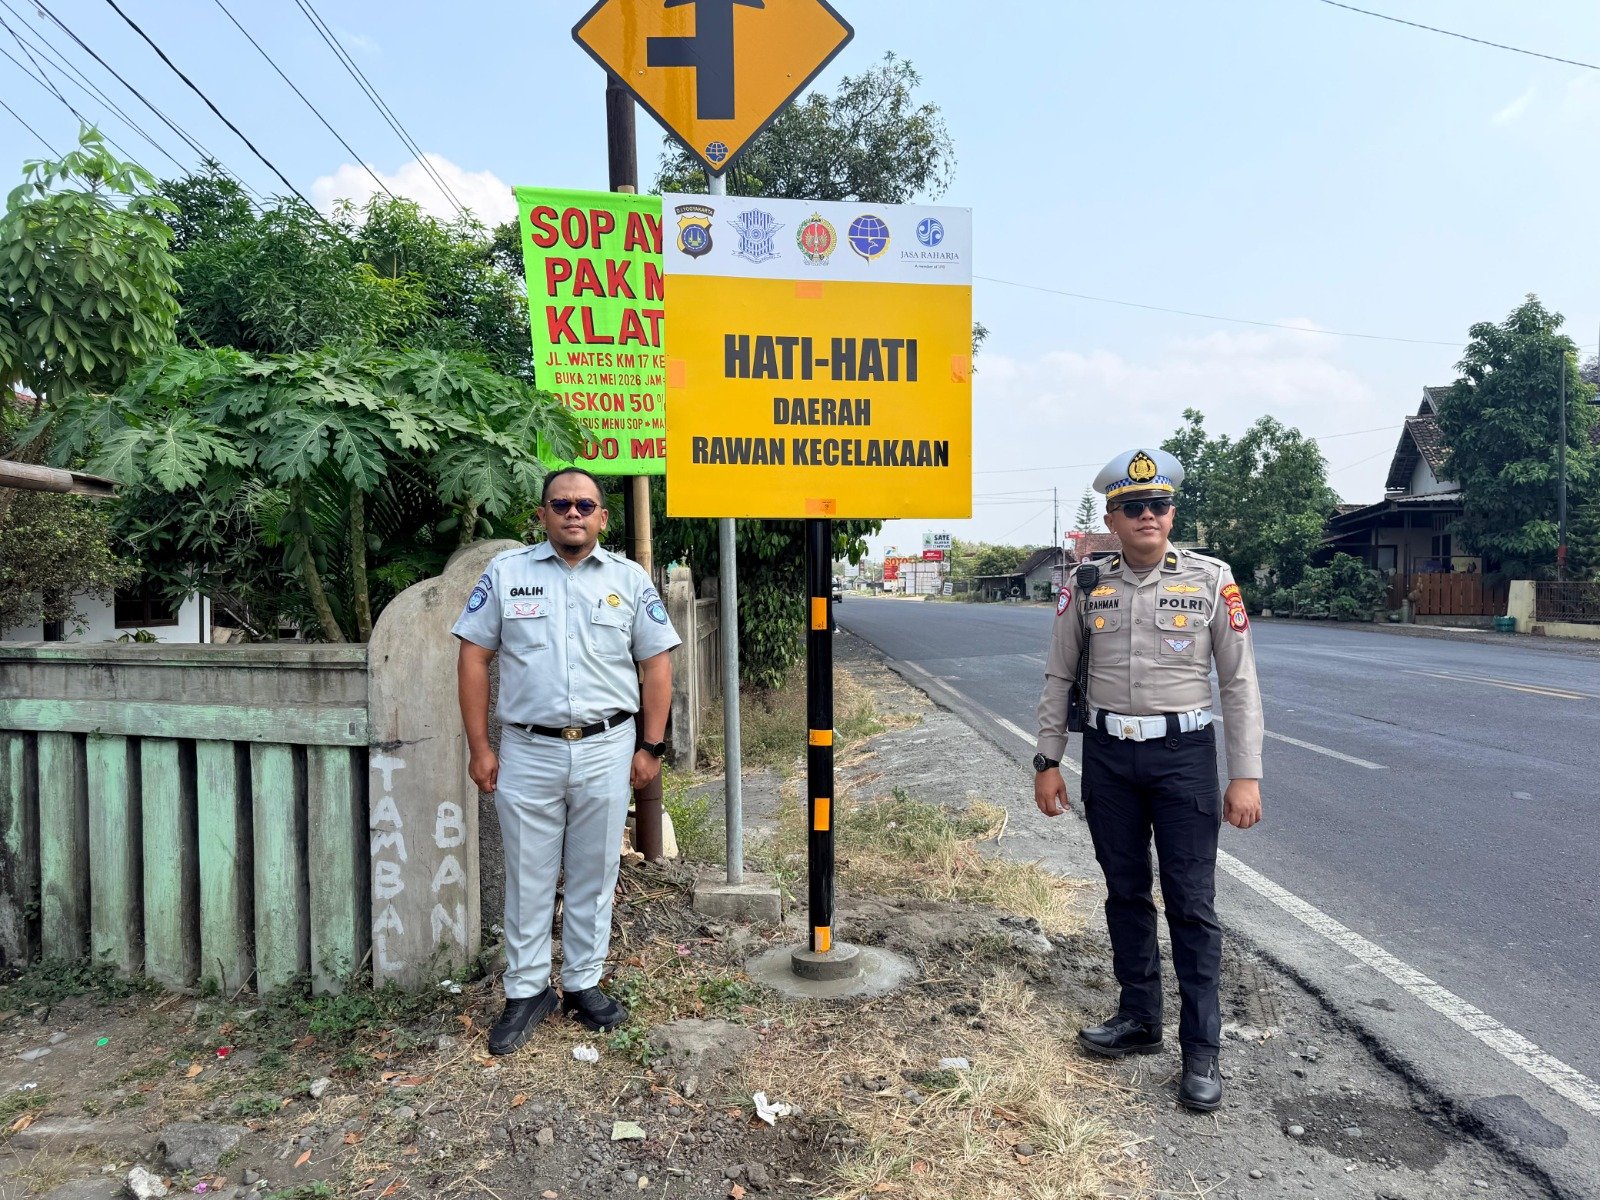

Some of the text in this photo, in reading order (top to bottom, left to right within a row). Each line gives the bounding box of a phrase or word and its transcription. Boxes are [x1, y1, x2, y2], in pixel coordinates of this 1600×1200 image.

[530, 205, 663, 254] SOP AY
[900, 251, 959, 260] JASA RAHARJA
[545, 257, 637, 299] PAK
[546, 305, 664, 348] KLAT
[616, 354, 635, 368] KM
[638, 354, 649, 369] 17
[724, 334, 917, 382] HATI-HATI
[555, 372, 584, 385] BUKA
[588, 373, 598, 386] 21
[600, 373, 617, 386] MEI
[619, 374, 641, 386] 2026
[602, 418, 625, 429] MENU
[627, 418, 643, 429] SOP
[773, 397, 871, 426] DAERAH
[692, 436, 949, 467] RAWAN KECELAKAAN
[510, 586, 544, 597] GALIH
[1160, 599, 1203, 611] POLRI
[370, 753, 408, 971] TAMBAL
[431, 800, 467, 950] BAN
